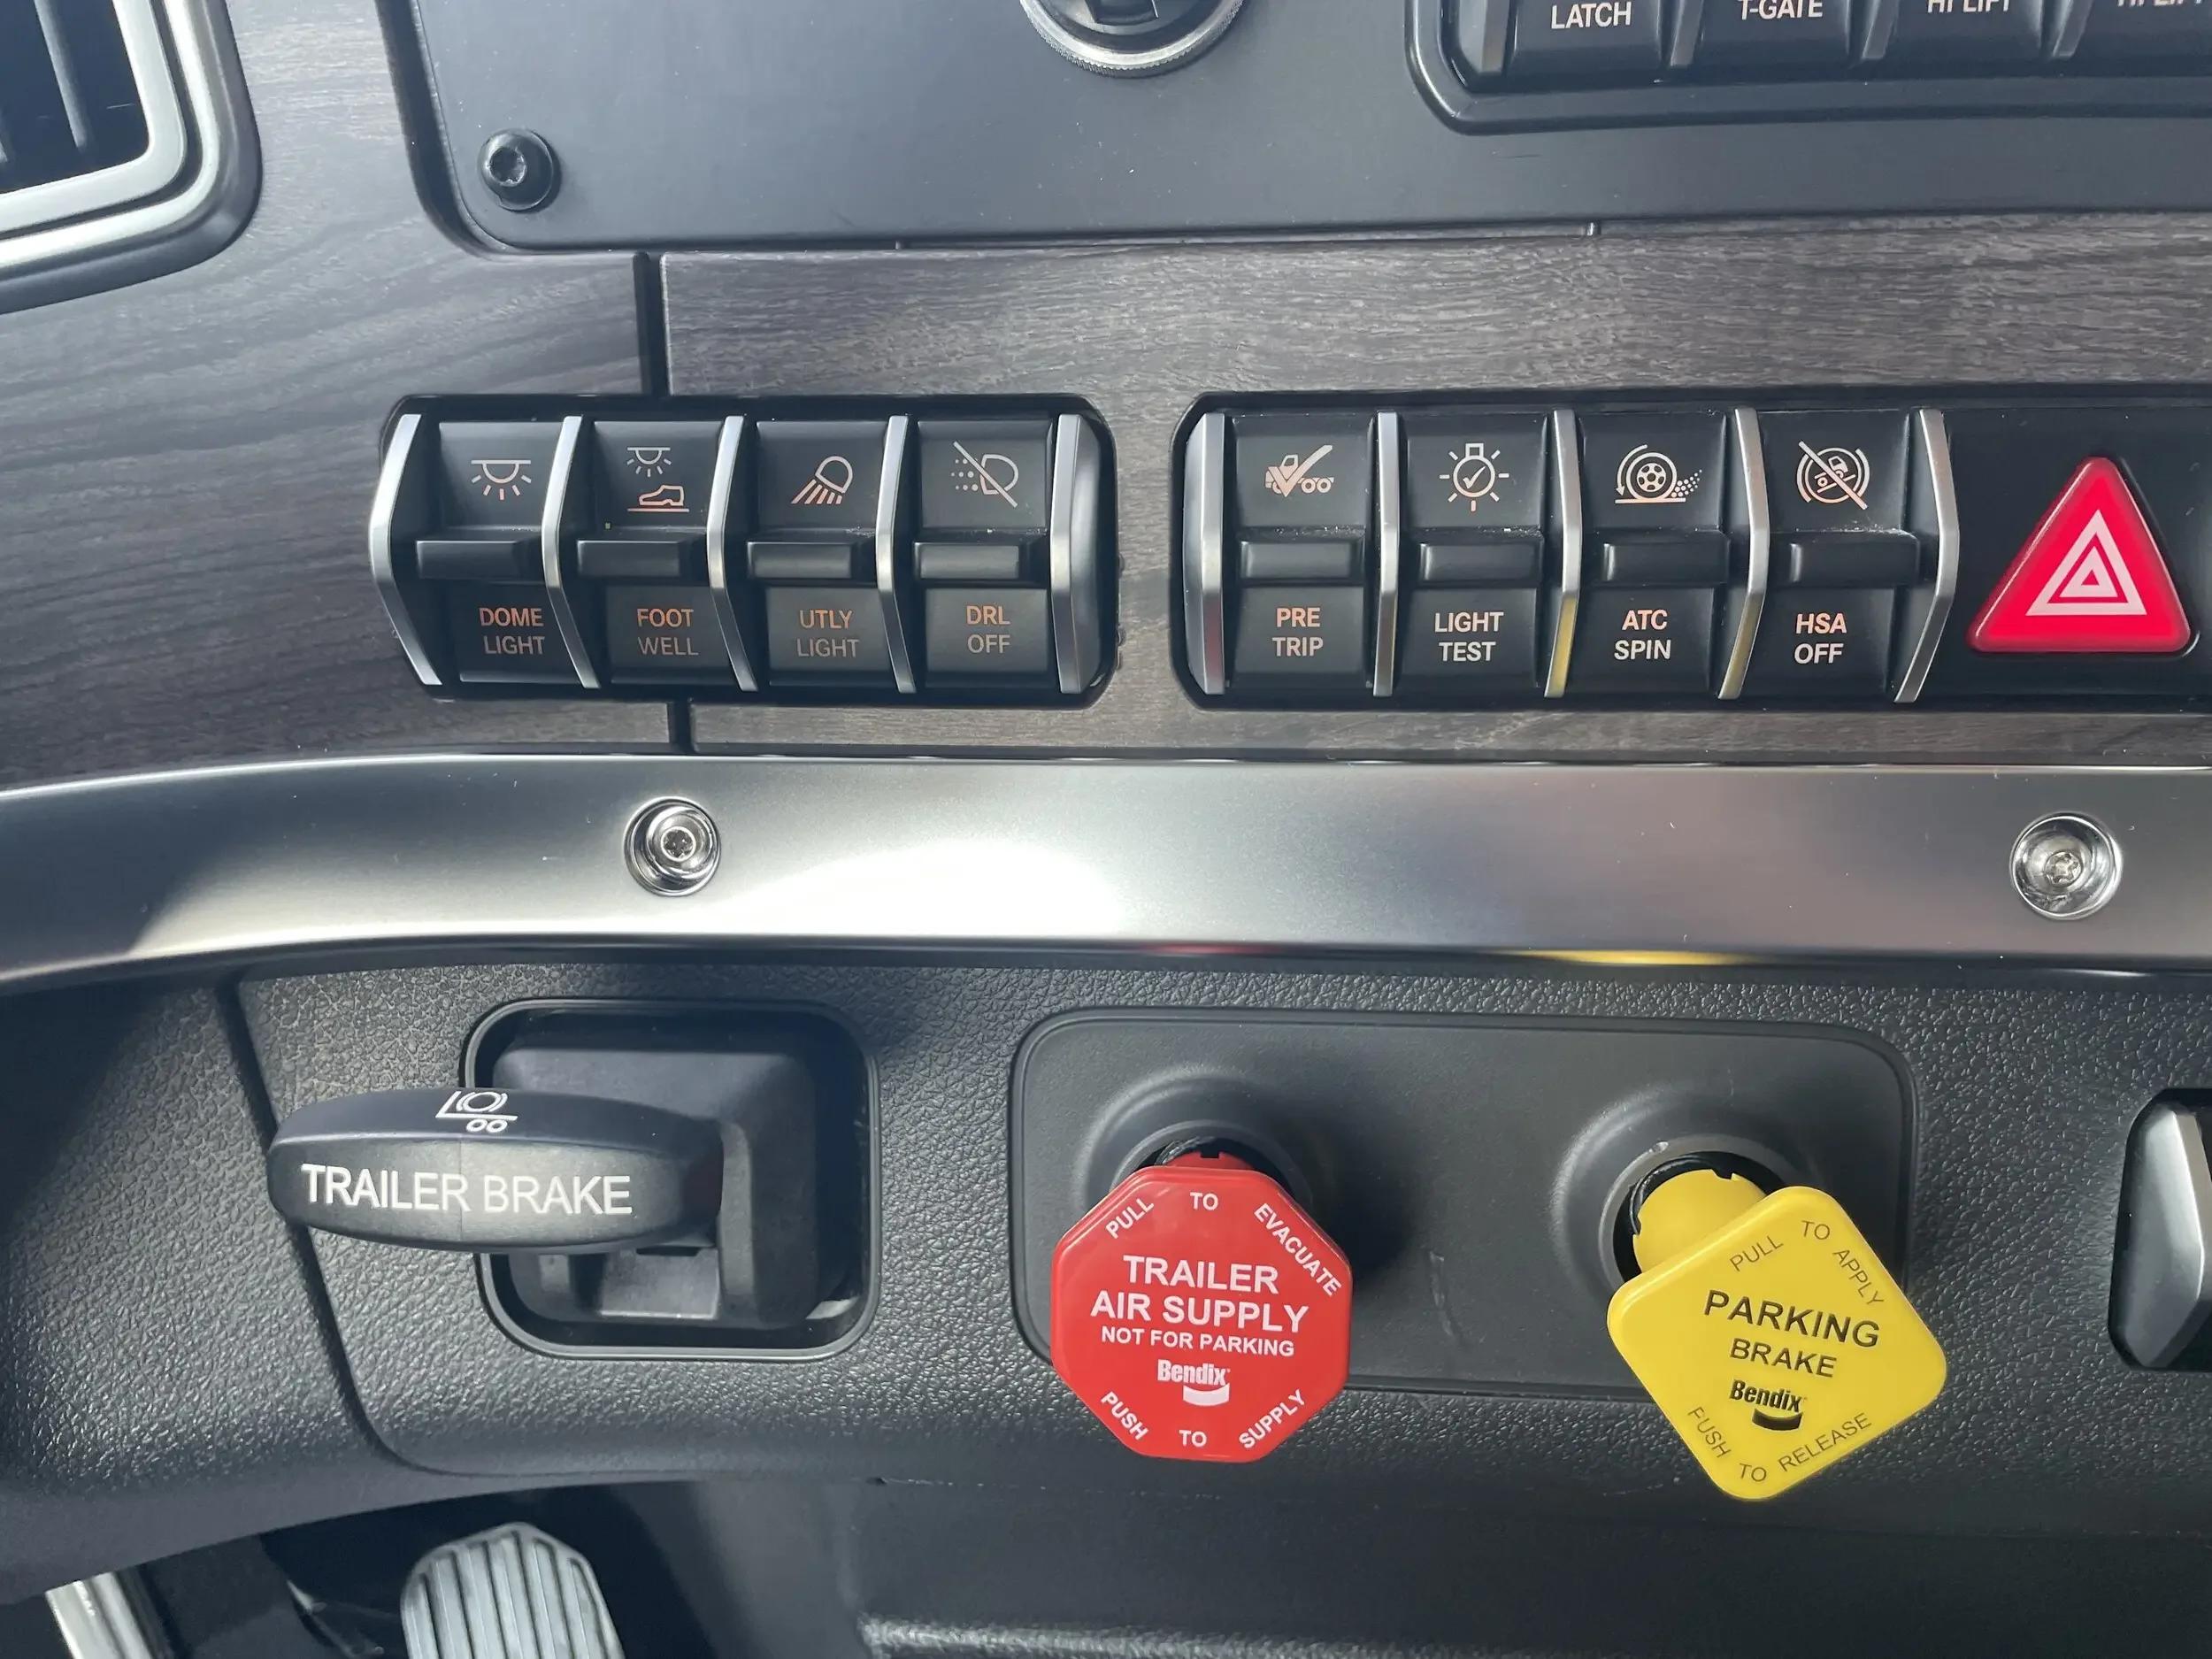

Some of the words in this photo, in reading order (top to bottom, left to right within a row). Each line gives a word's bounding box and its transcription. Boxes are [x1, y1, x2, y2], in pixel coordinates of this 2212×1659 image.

[1551, 2, 1632, 29] LATCH
[1739, 0, 1823, 19] T-GATE
[479, 607, 544, 626] DOME
[637, 608, 694, 627] FOOT
[800, 609, 853, 629] UTLY
[966, 605, 1010, 626] DRL
[1276, 607, 1321, 627] PRE
[1434, 611, 1504, 633] LIGHT
[1622, 609, 1668, 631] ATC
[1795, 612, 1847, 634] HSA
[483, 635, 545, 655] LIGHT
[637, 636, 699, 656] WELL
[797, 638, 860, 657] LIGHT
[967, 634, 1010, 654] OFF
[1271, 636, 1324, 657] TRIP
[1439, 641, 1496, 662] TEST
[1614, 639, 1671, 660] SPIN
[1793, 643, 1844, 664] OFF
[301, 1164, 470, 1212] TRAILER
[484, 1174, 633, 1216] BRAKE
[1105, 1197, 1154, 1239] PULL
[1190, 1192, 1219, 1211] TO
[1253, 1203, 1341, 1297] EVACUATE
[1123, 1255, 1279, 1294] TRAILER
[1730, 1235, 1784, 1271] PULL
[1801, 1220, 1831, 1240] TO
[1832, 1248, 1885, 1307] APPLY
[1090, 1290, 1151, 1321] AIR
[1162, 1295, 1309, 1333] SUPPLY
[1703, 1289, 1880, 1348] PARKING
[1101, 1326, 1145, 1346] NOT
[1150, 1330, 1194, 1349] FOR
[1199, 1335, 1294, 1357] PARKING
[1730, 1337, 1837, 1378] BRAKE
[1157, 1359, 1226, 1386] Bendix
[1729, 1379, 1802, 1413] Bendix
[1101, 1391, 1148, 1440] PUSH
[1179, 1429, 1207, 1448] TO
[1239, 1389, 1306, 1448] SUPPLY
[1687, 1406, 1732, 1458] PUSH
[1739, 1463, 1768, 1483] TO
[1778, 1412, 1871, 1472] RELEASE
